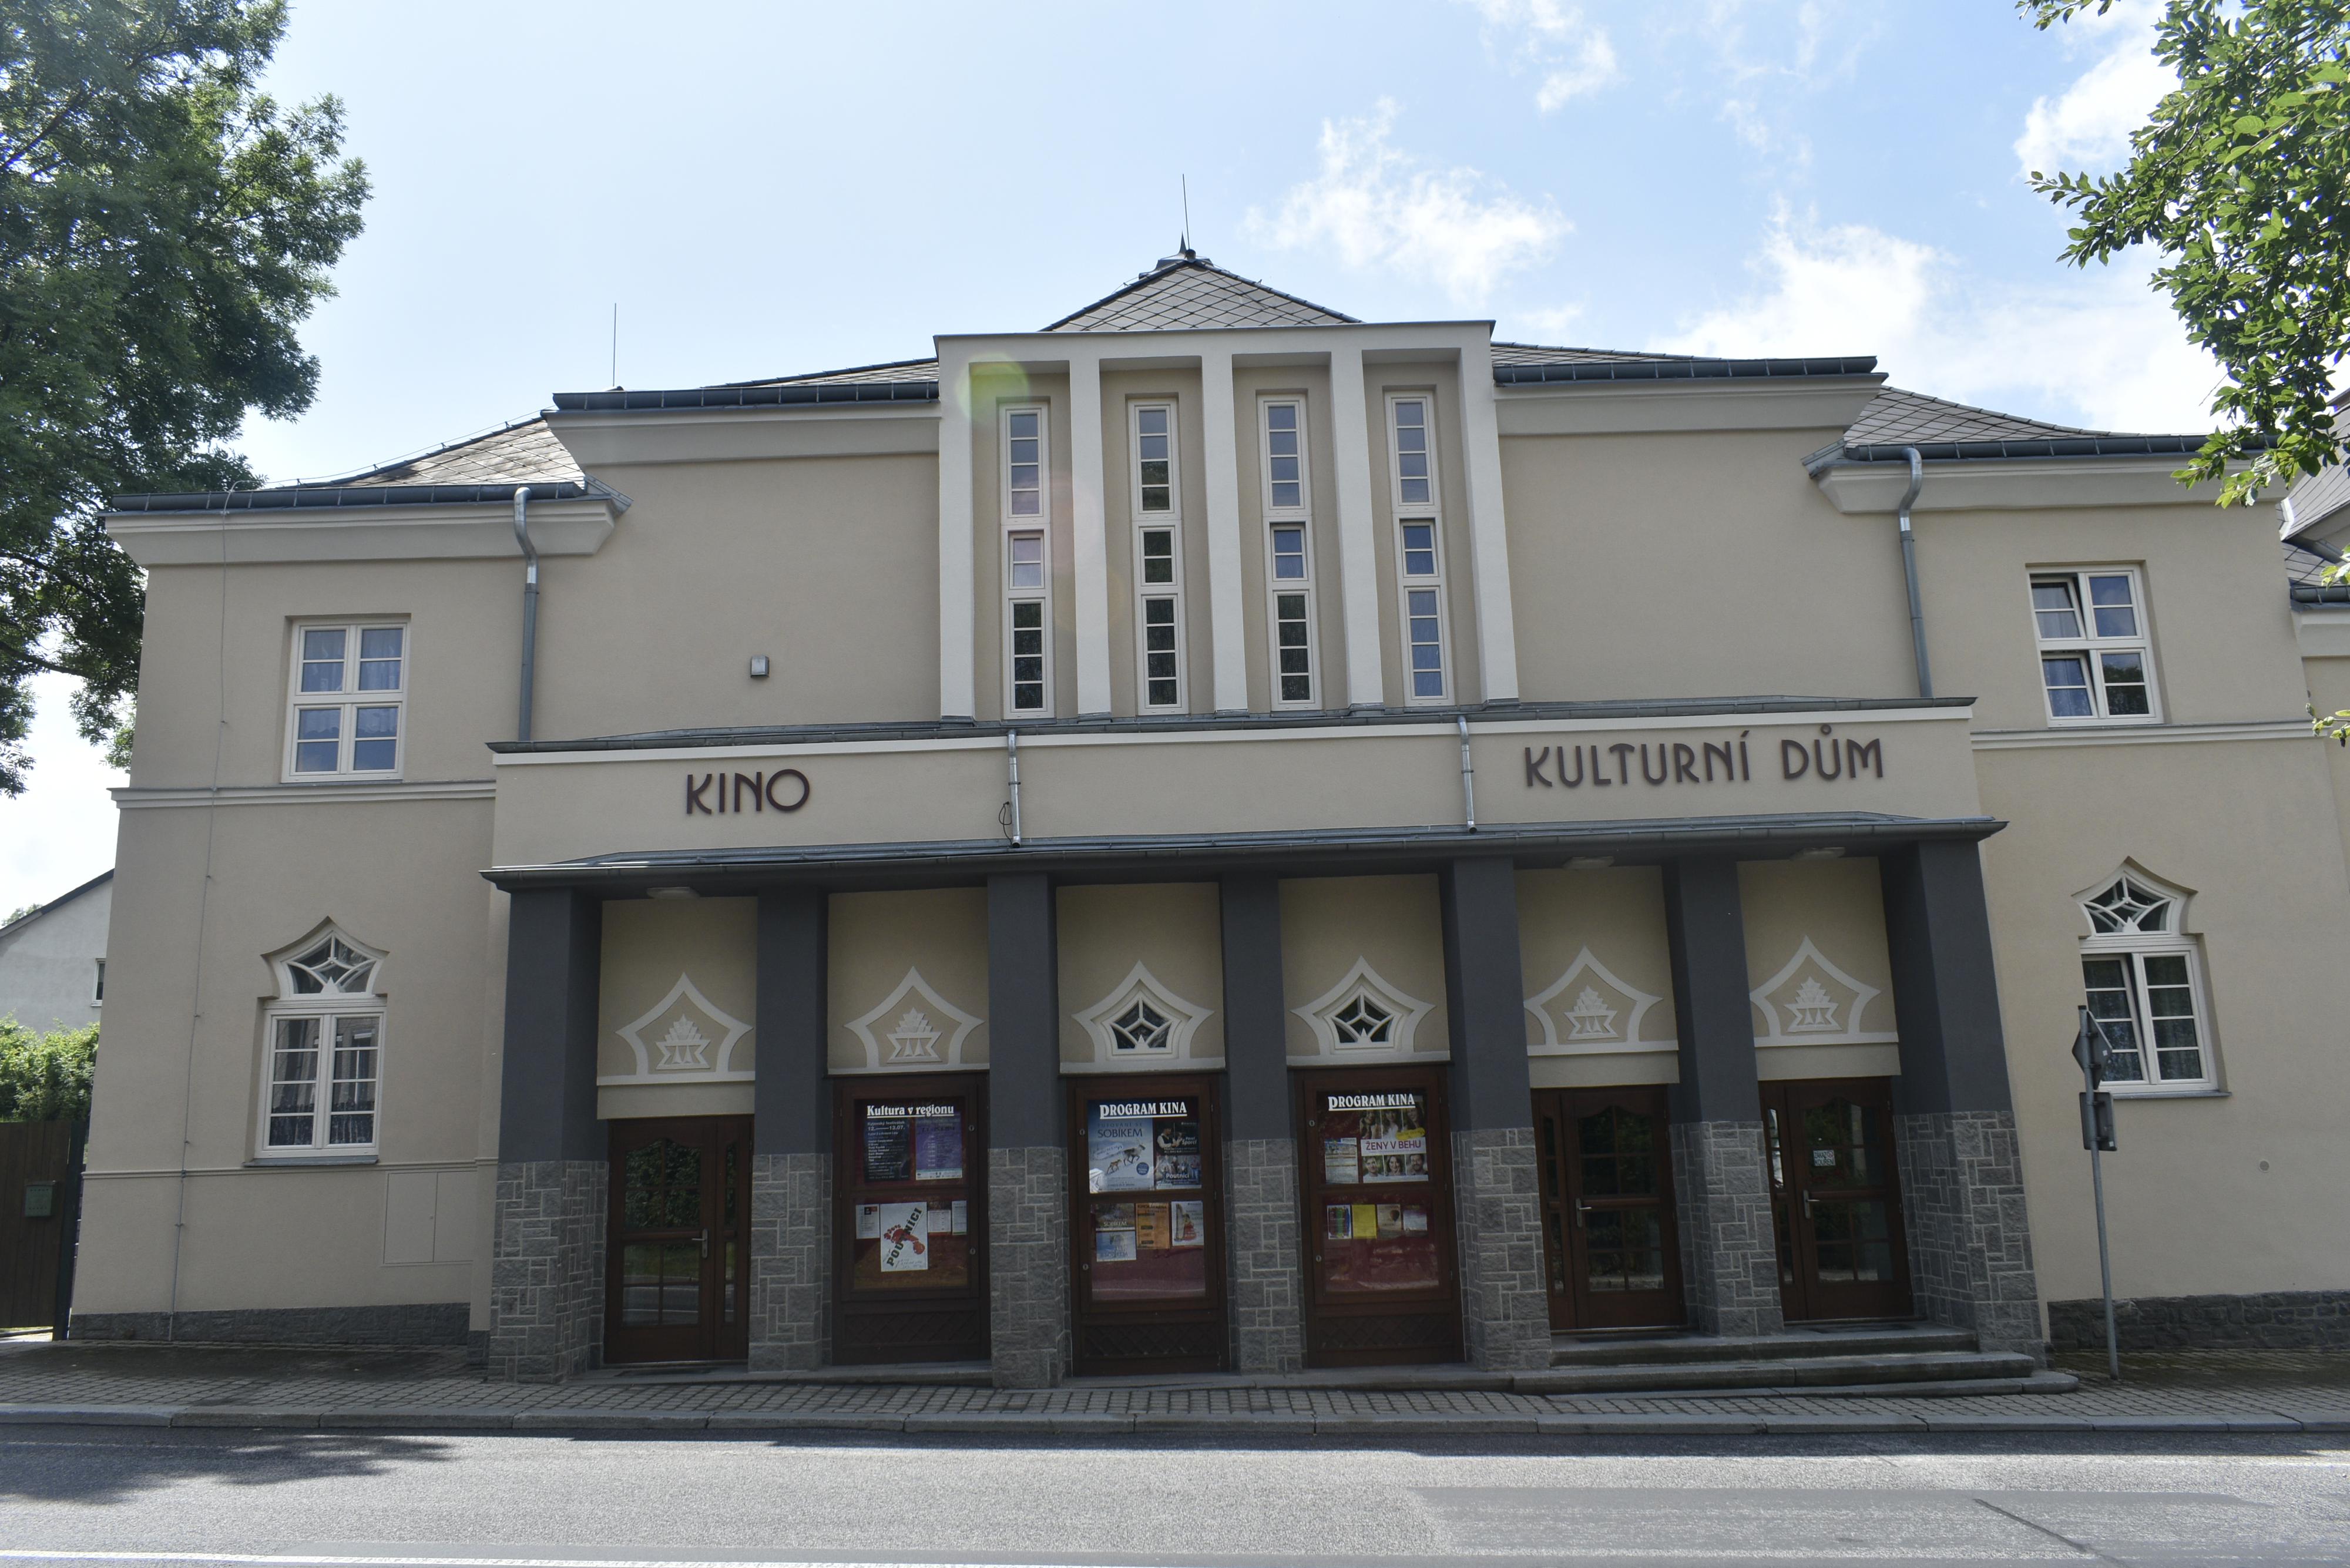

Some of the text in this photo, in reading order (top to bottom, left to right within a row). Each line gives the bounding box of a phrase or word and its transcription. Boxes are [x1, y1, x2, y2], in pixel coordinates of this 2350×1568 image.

[1525, 723, 1884, 788] KULTURNÍ DŮM
[686, 768, 810, 815] KINO
[1328, 1093, 1415, 1110] PROGRAM KINA
[867, 1105, 905, 1116] Kultura
[915, 1104, 955, 1117] regionu
[1099, 1102, 1187, 1118] PROGRAM KINA
[1097, 1127, 1143, 1138] SOBÍKEM
[1366, 1141, 1389, 1150] ŽENY
